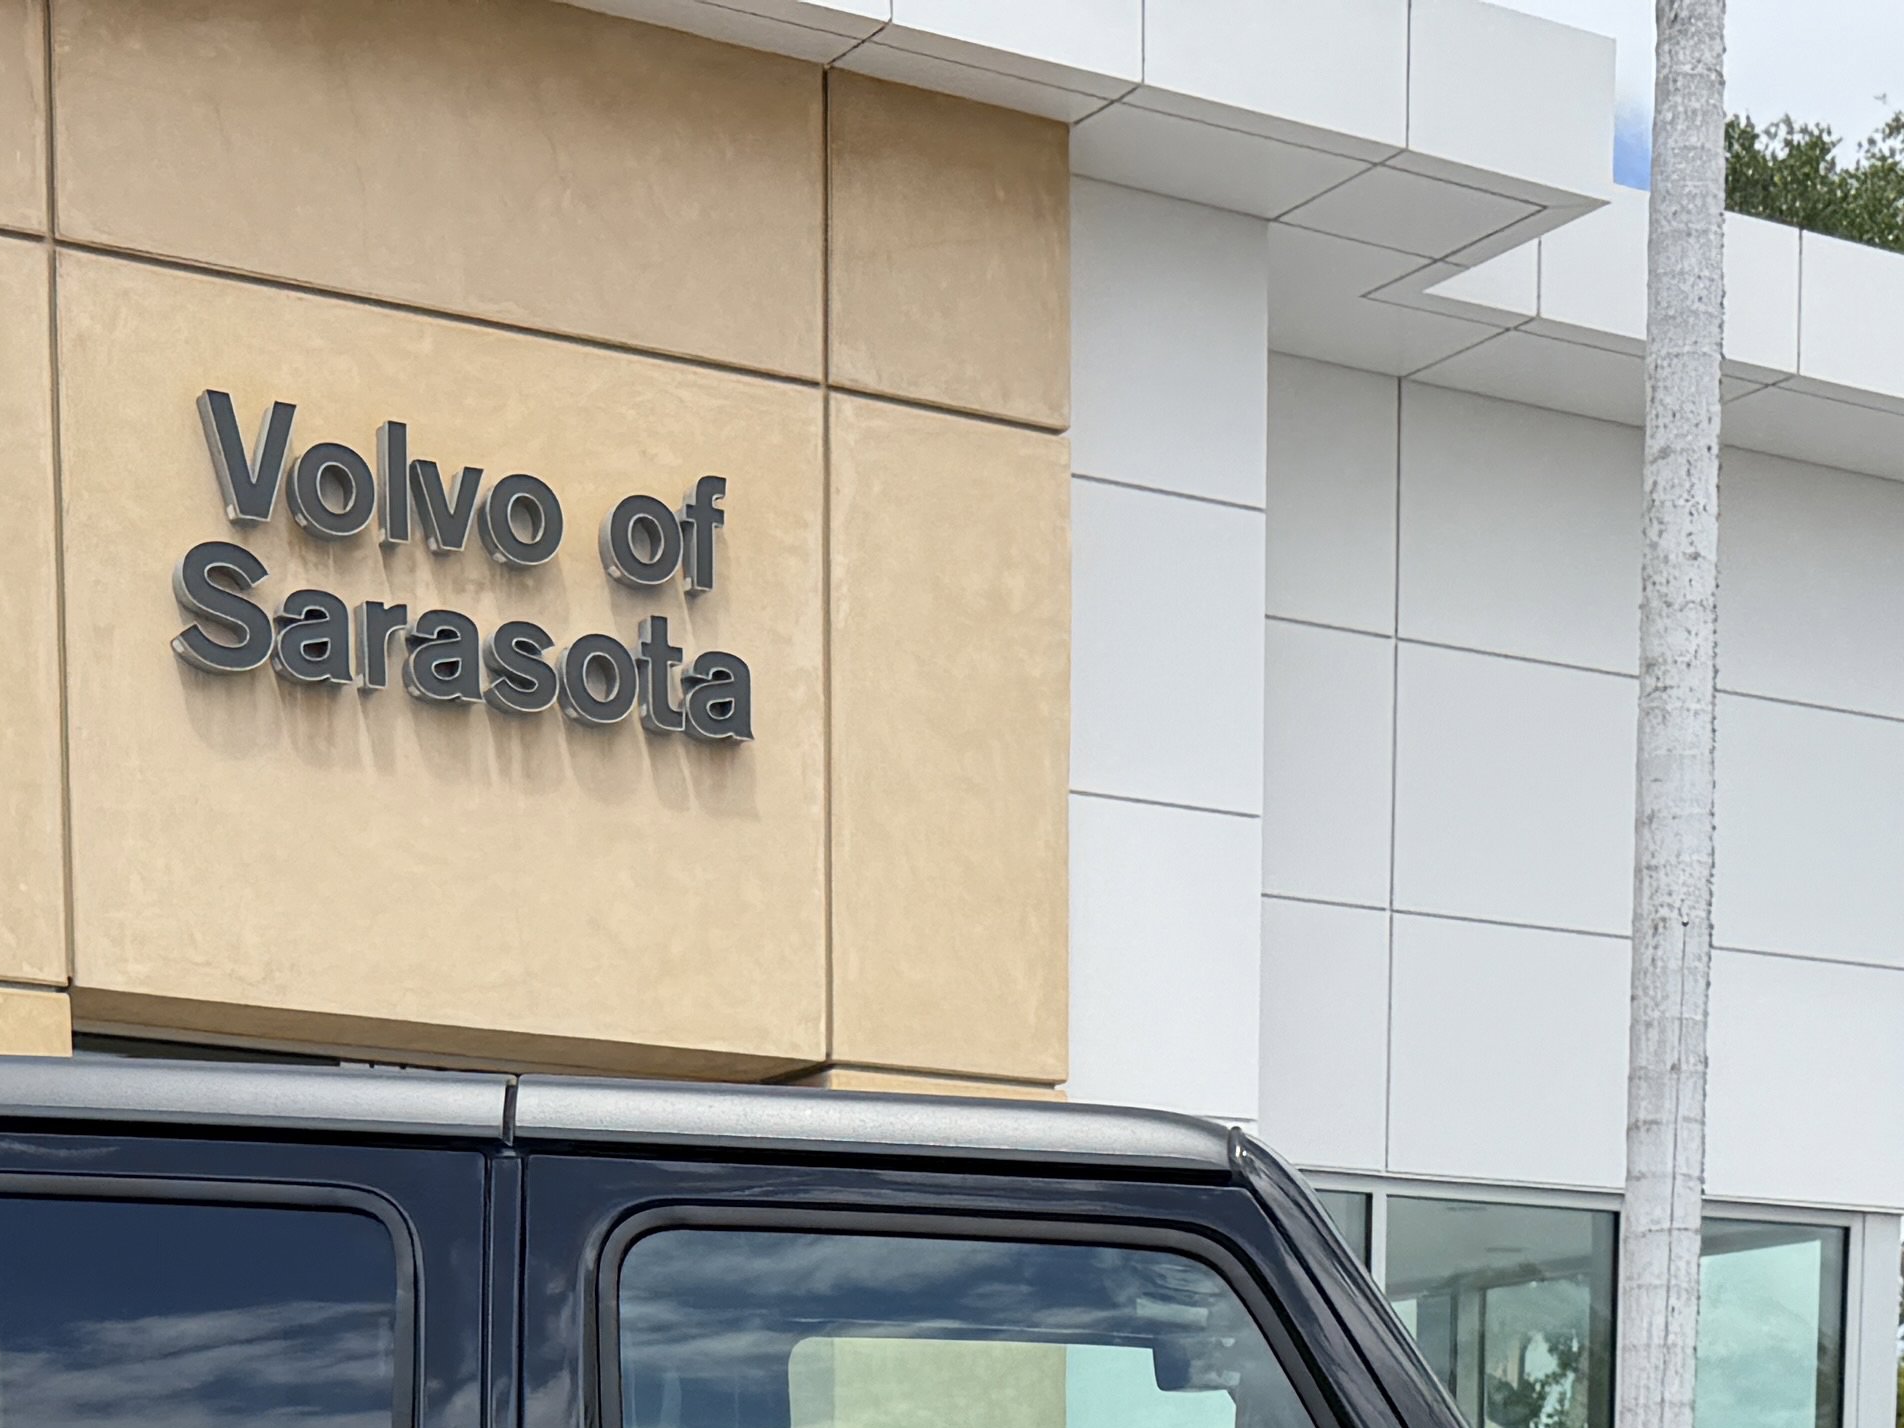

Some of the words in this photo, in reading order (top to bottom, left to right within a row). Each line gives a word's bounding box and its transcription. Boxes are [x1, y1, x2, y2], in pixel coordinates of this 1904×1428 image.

[196, 388, 564, 567] Volvo
[598, 474, 727, 598] of
[170, 539, 755, 744] Sarasota
